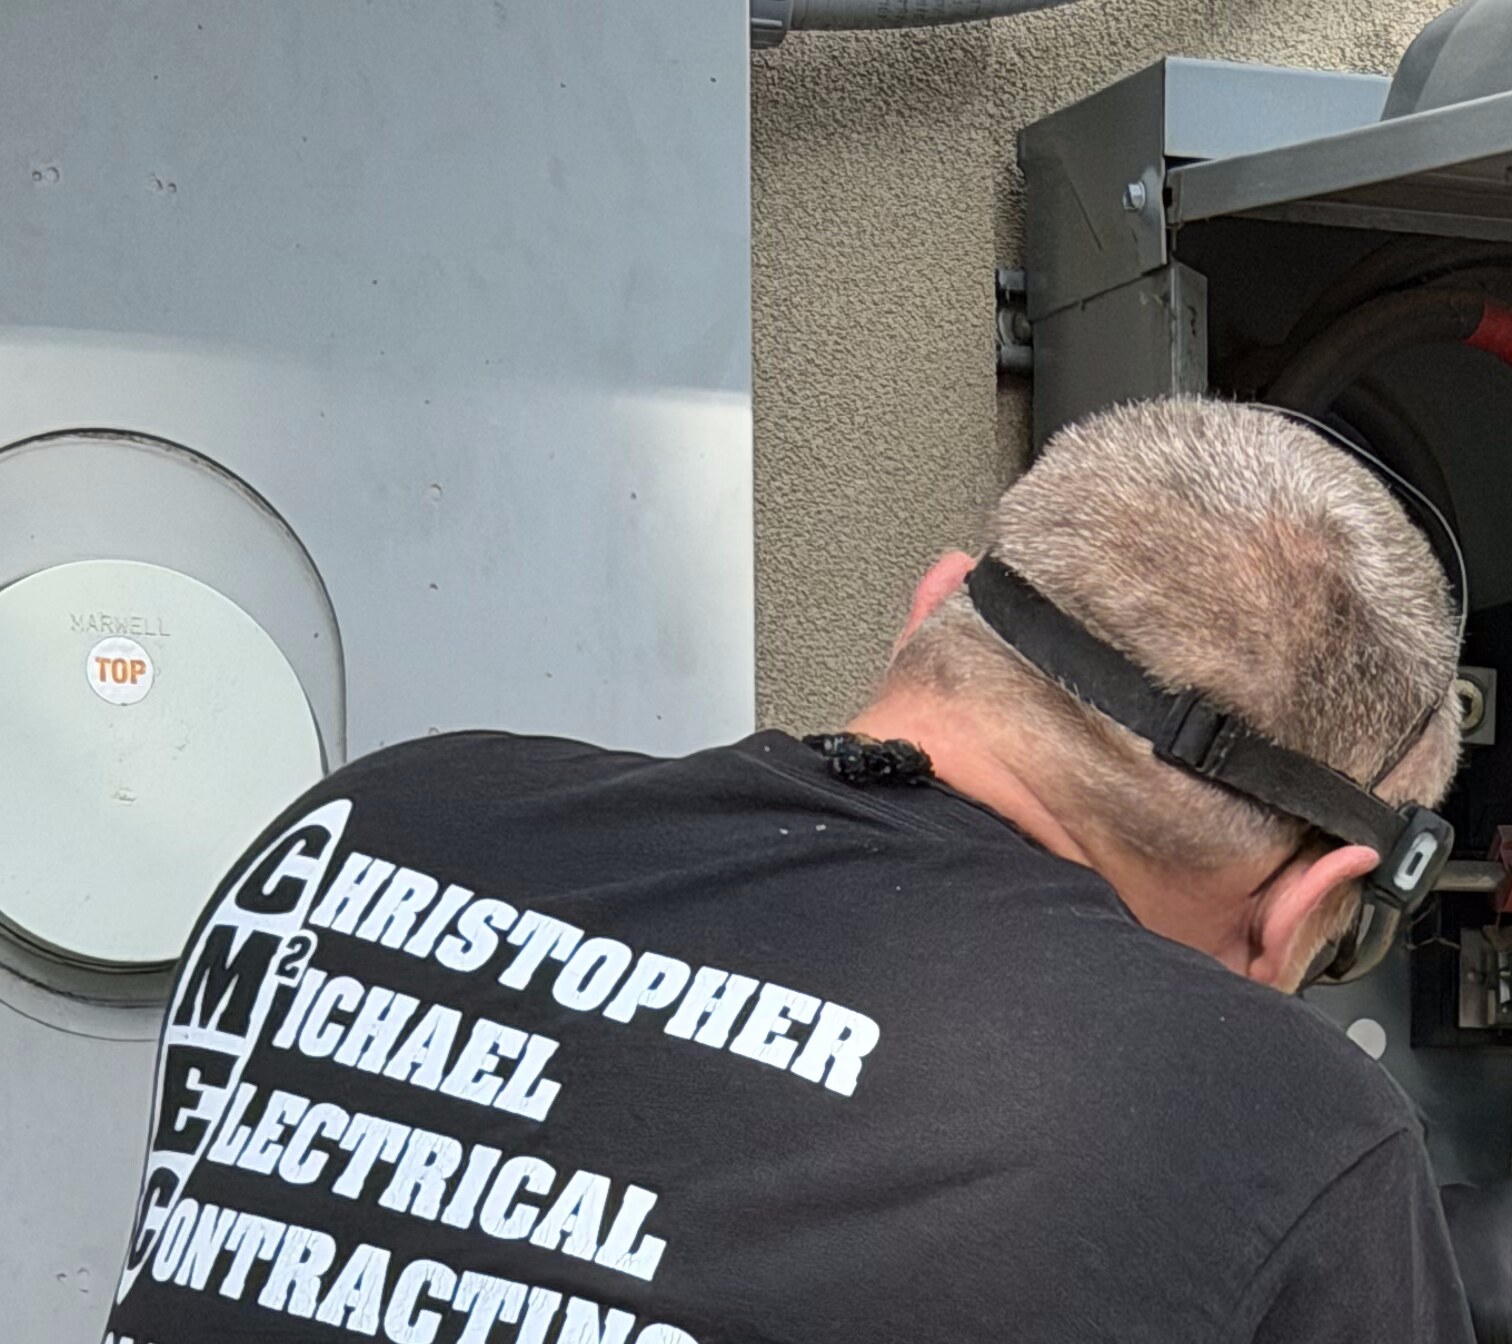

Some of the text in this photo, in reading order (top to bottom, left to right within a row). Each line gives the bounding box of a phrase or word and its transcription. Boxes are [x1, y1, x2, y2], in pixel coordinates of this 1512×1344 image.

[95, 656, 147, 684] TOP
[172, 926, 562, 1122] MICHAEL
[236, 822, 881, 1097] CHRISTOPHER
[153, 1041, 667, 1281] ELECTRICAL
